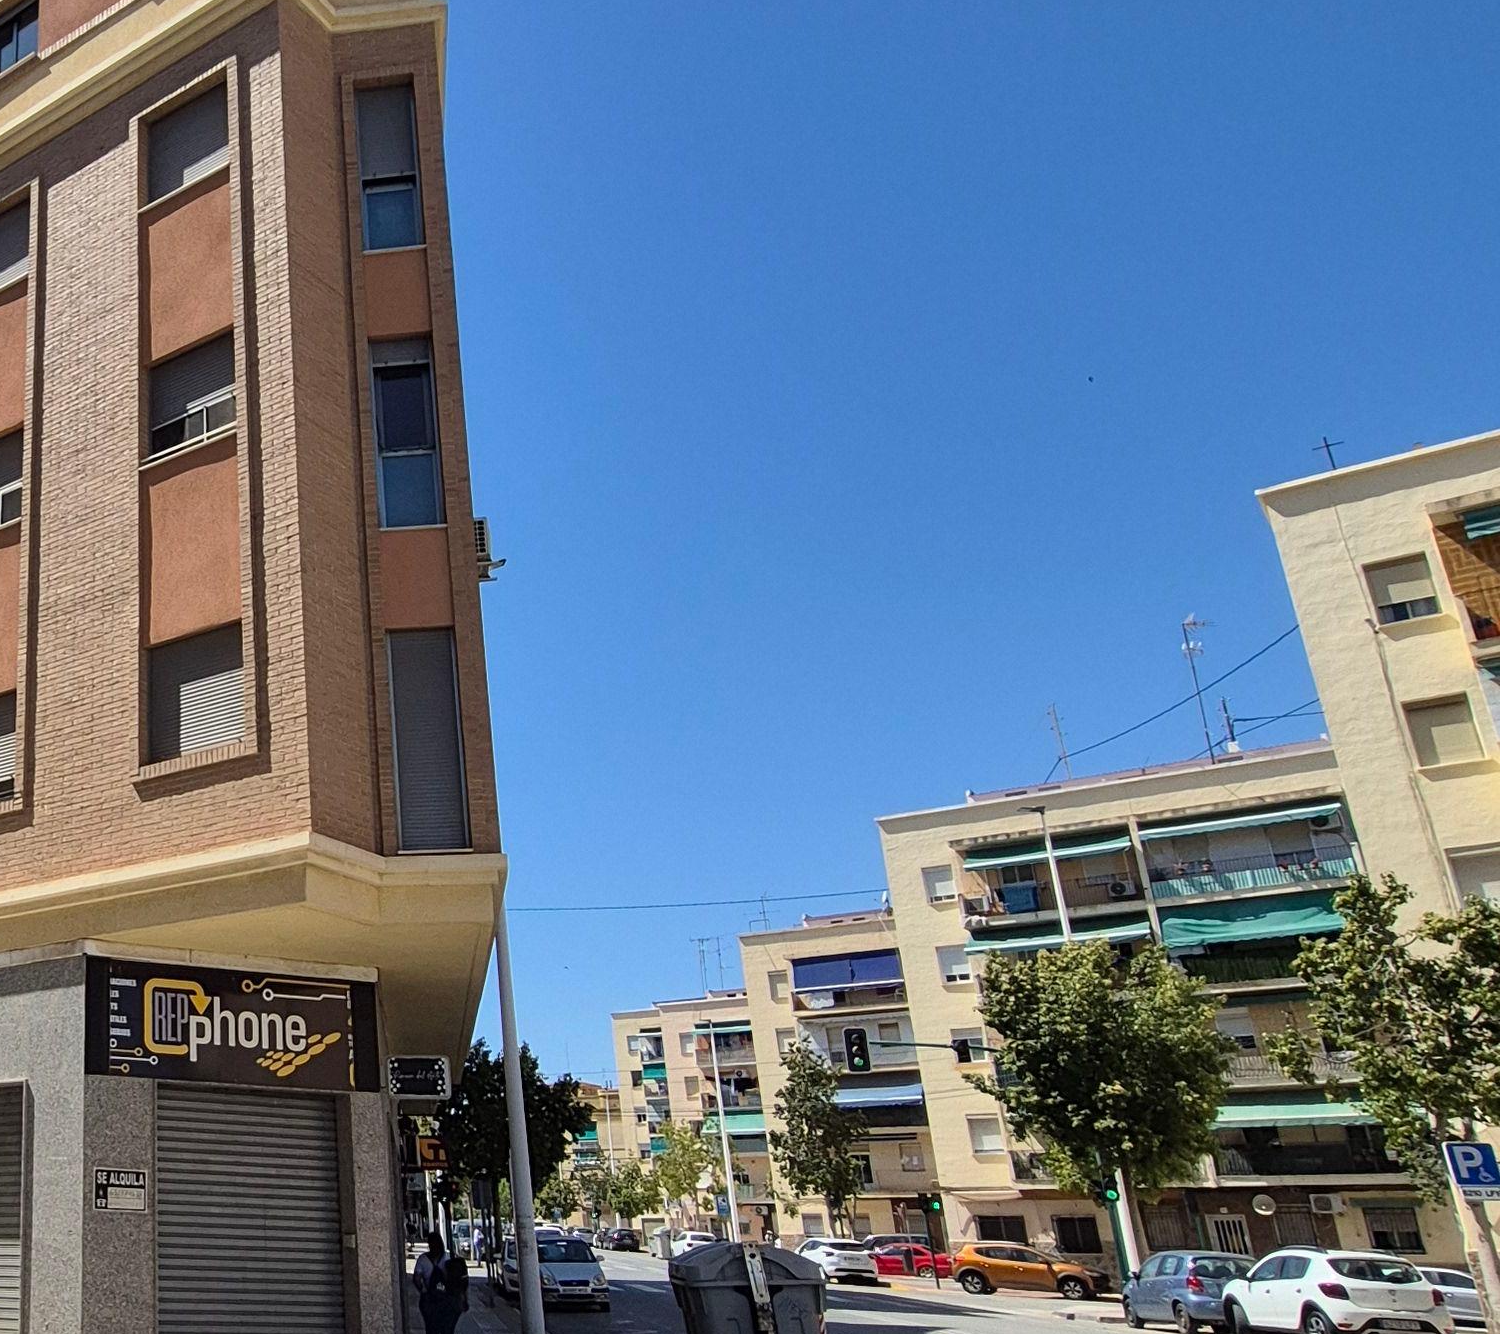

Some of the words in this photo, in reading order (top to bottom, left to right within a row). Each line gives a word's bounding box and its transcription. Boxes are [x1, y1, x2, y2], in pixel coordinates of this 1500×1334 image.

[1452, 1145, 1483, 1179] P
[96, 1171, 108, 1185] SE
[109, 1171, 145, 1187] ALQUILA
